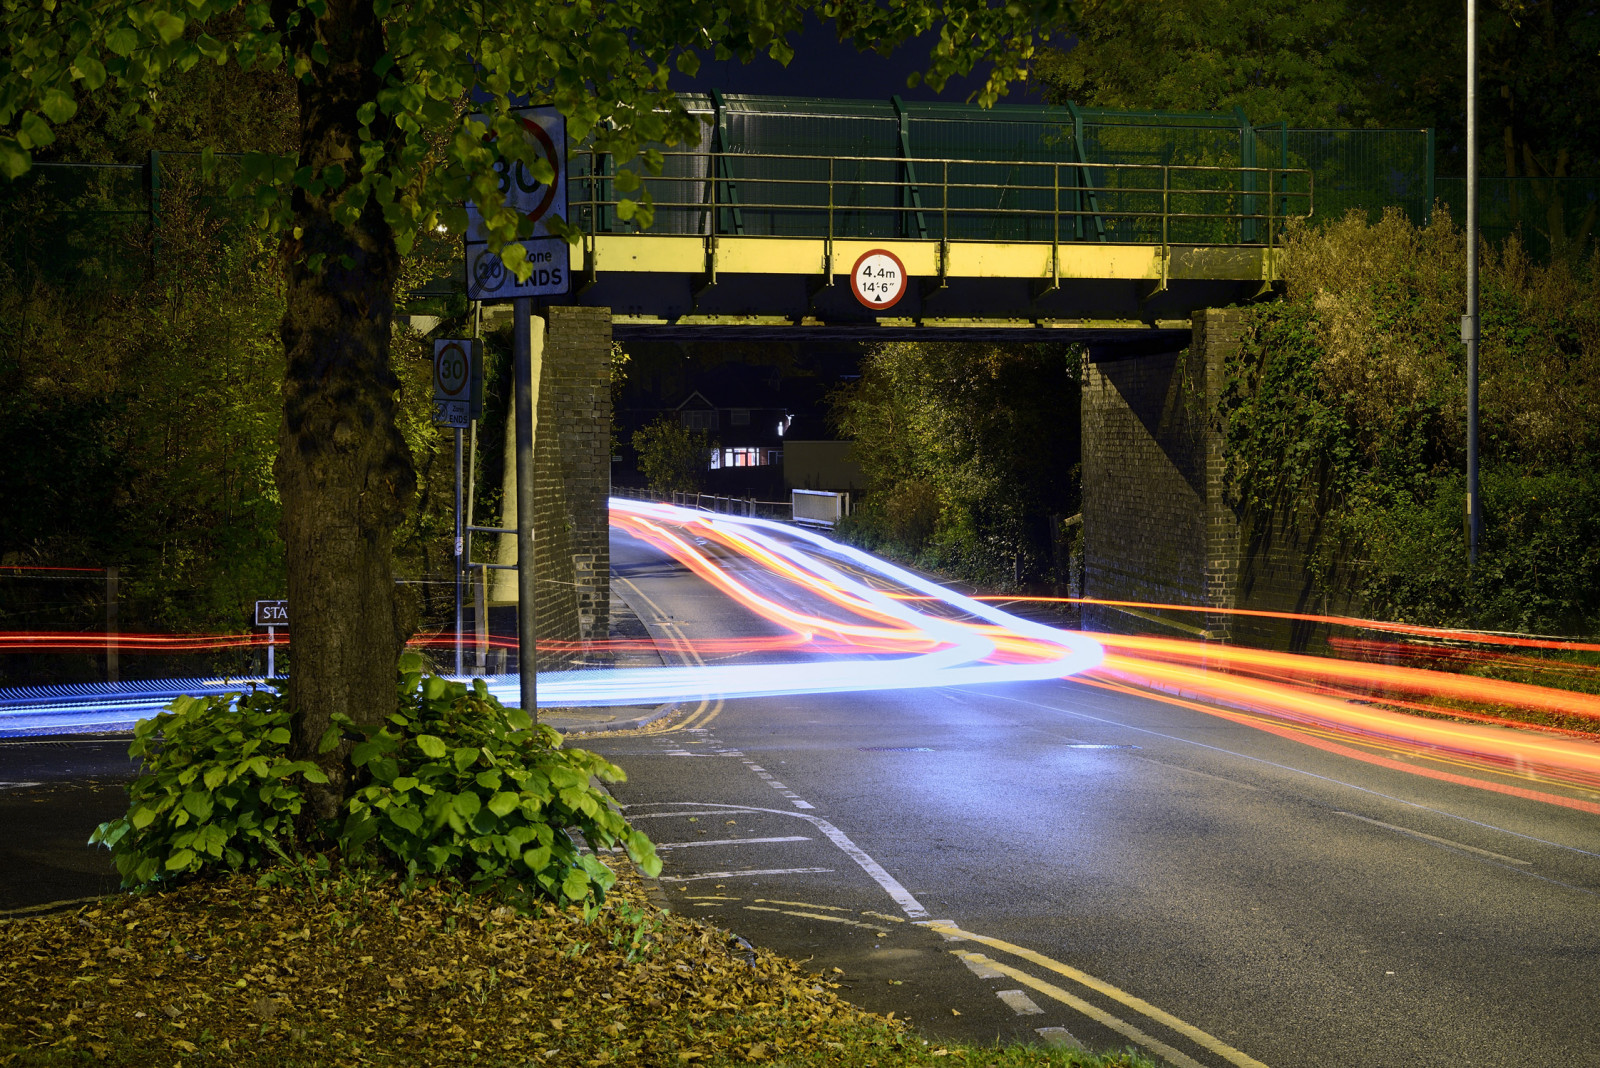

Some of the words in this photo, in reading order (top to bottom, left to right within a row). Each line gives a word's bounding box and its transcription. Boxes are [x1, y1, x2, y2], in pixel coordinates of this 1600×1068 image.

[524, 251, 552, 263] one
[863, 266, 896, 279] 4.4m
[442, 360, 462, 379] 30
[449, 415, 468, 424] ENDS
[263, 606, 288, 619] STA
